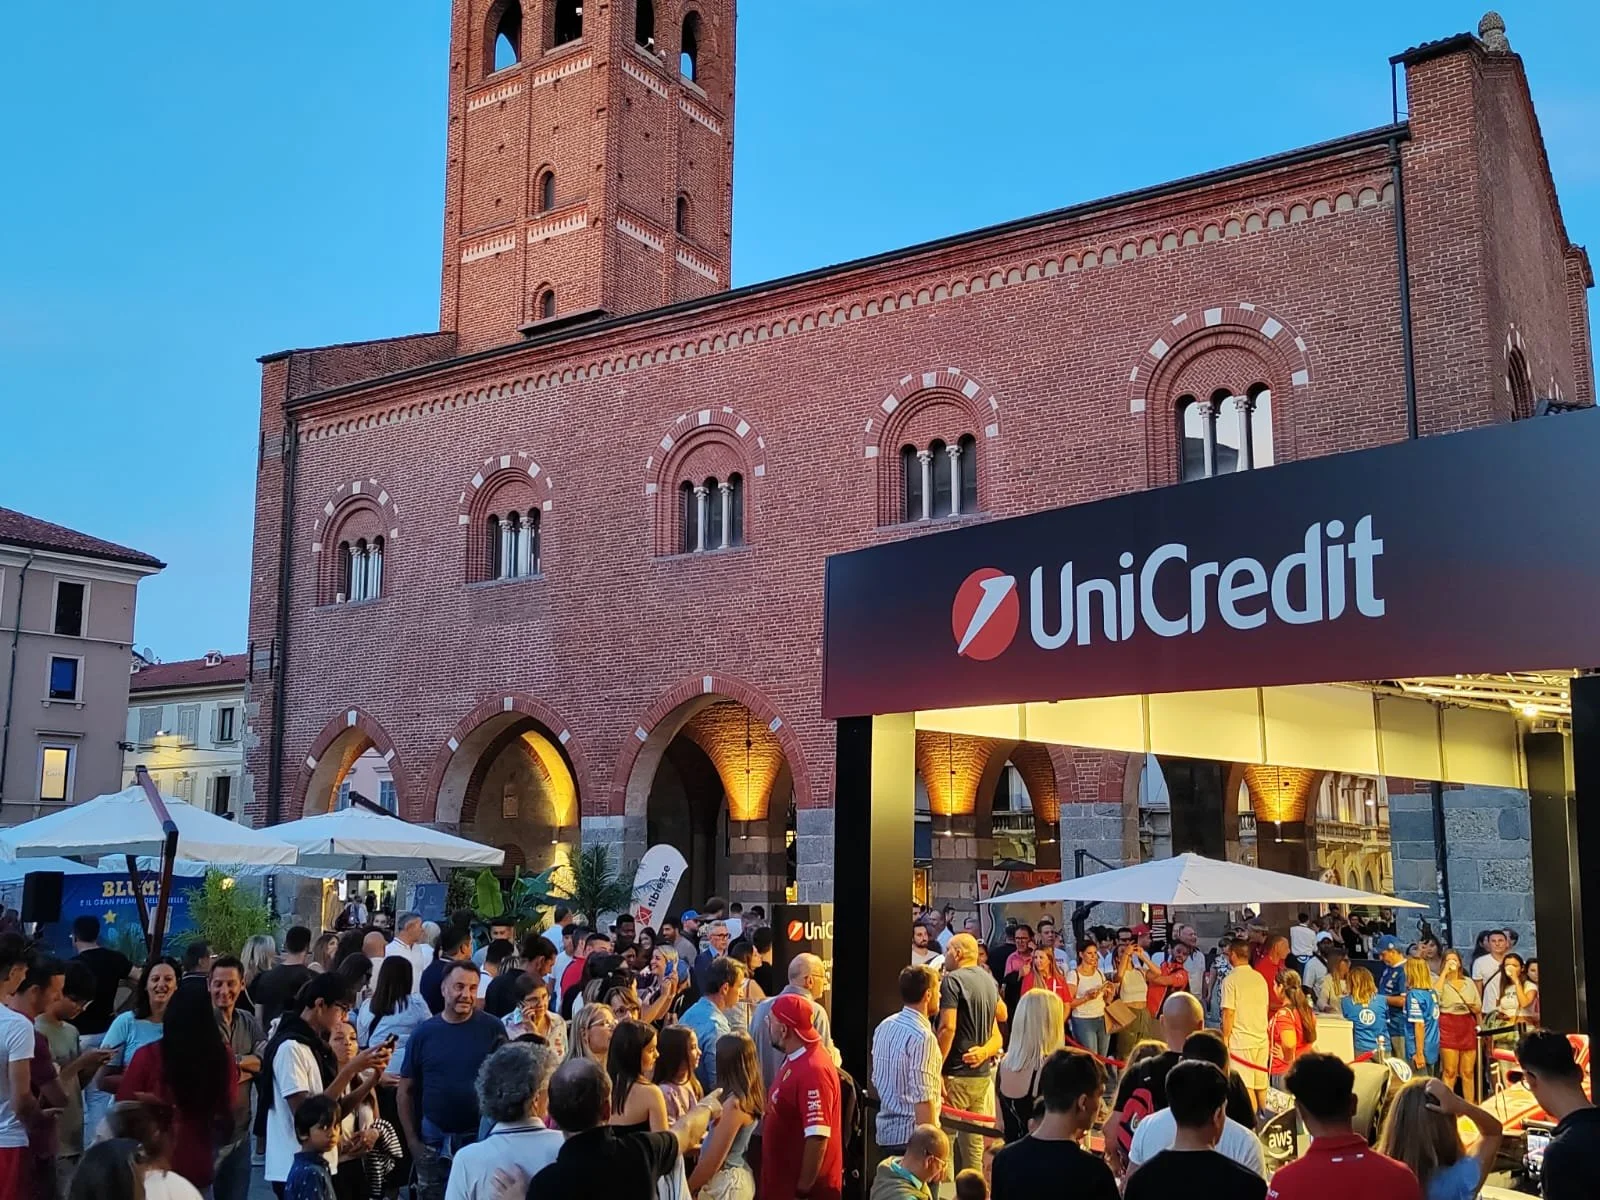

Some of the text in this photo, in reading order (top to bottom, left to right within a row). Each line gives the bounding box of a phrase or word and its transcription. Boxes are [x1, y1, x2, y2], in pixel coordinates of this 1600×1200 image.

[1030, 514, 1385, 650] UniCredit
[93, 898, 114, 906] GRAN
[115, 897, 137, 905] PREMI
[1361, 1009, 1375, 1025] hp
[1268, 1129, 1293, 1149] aws
